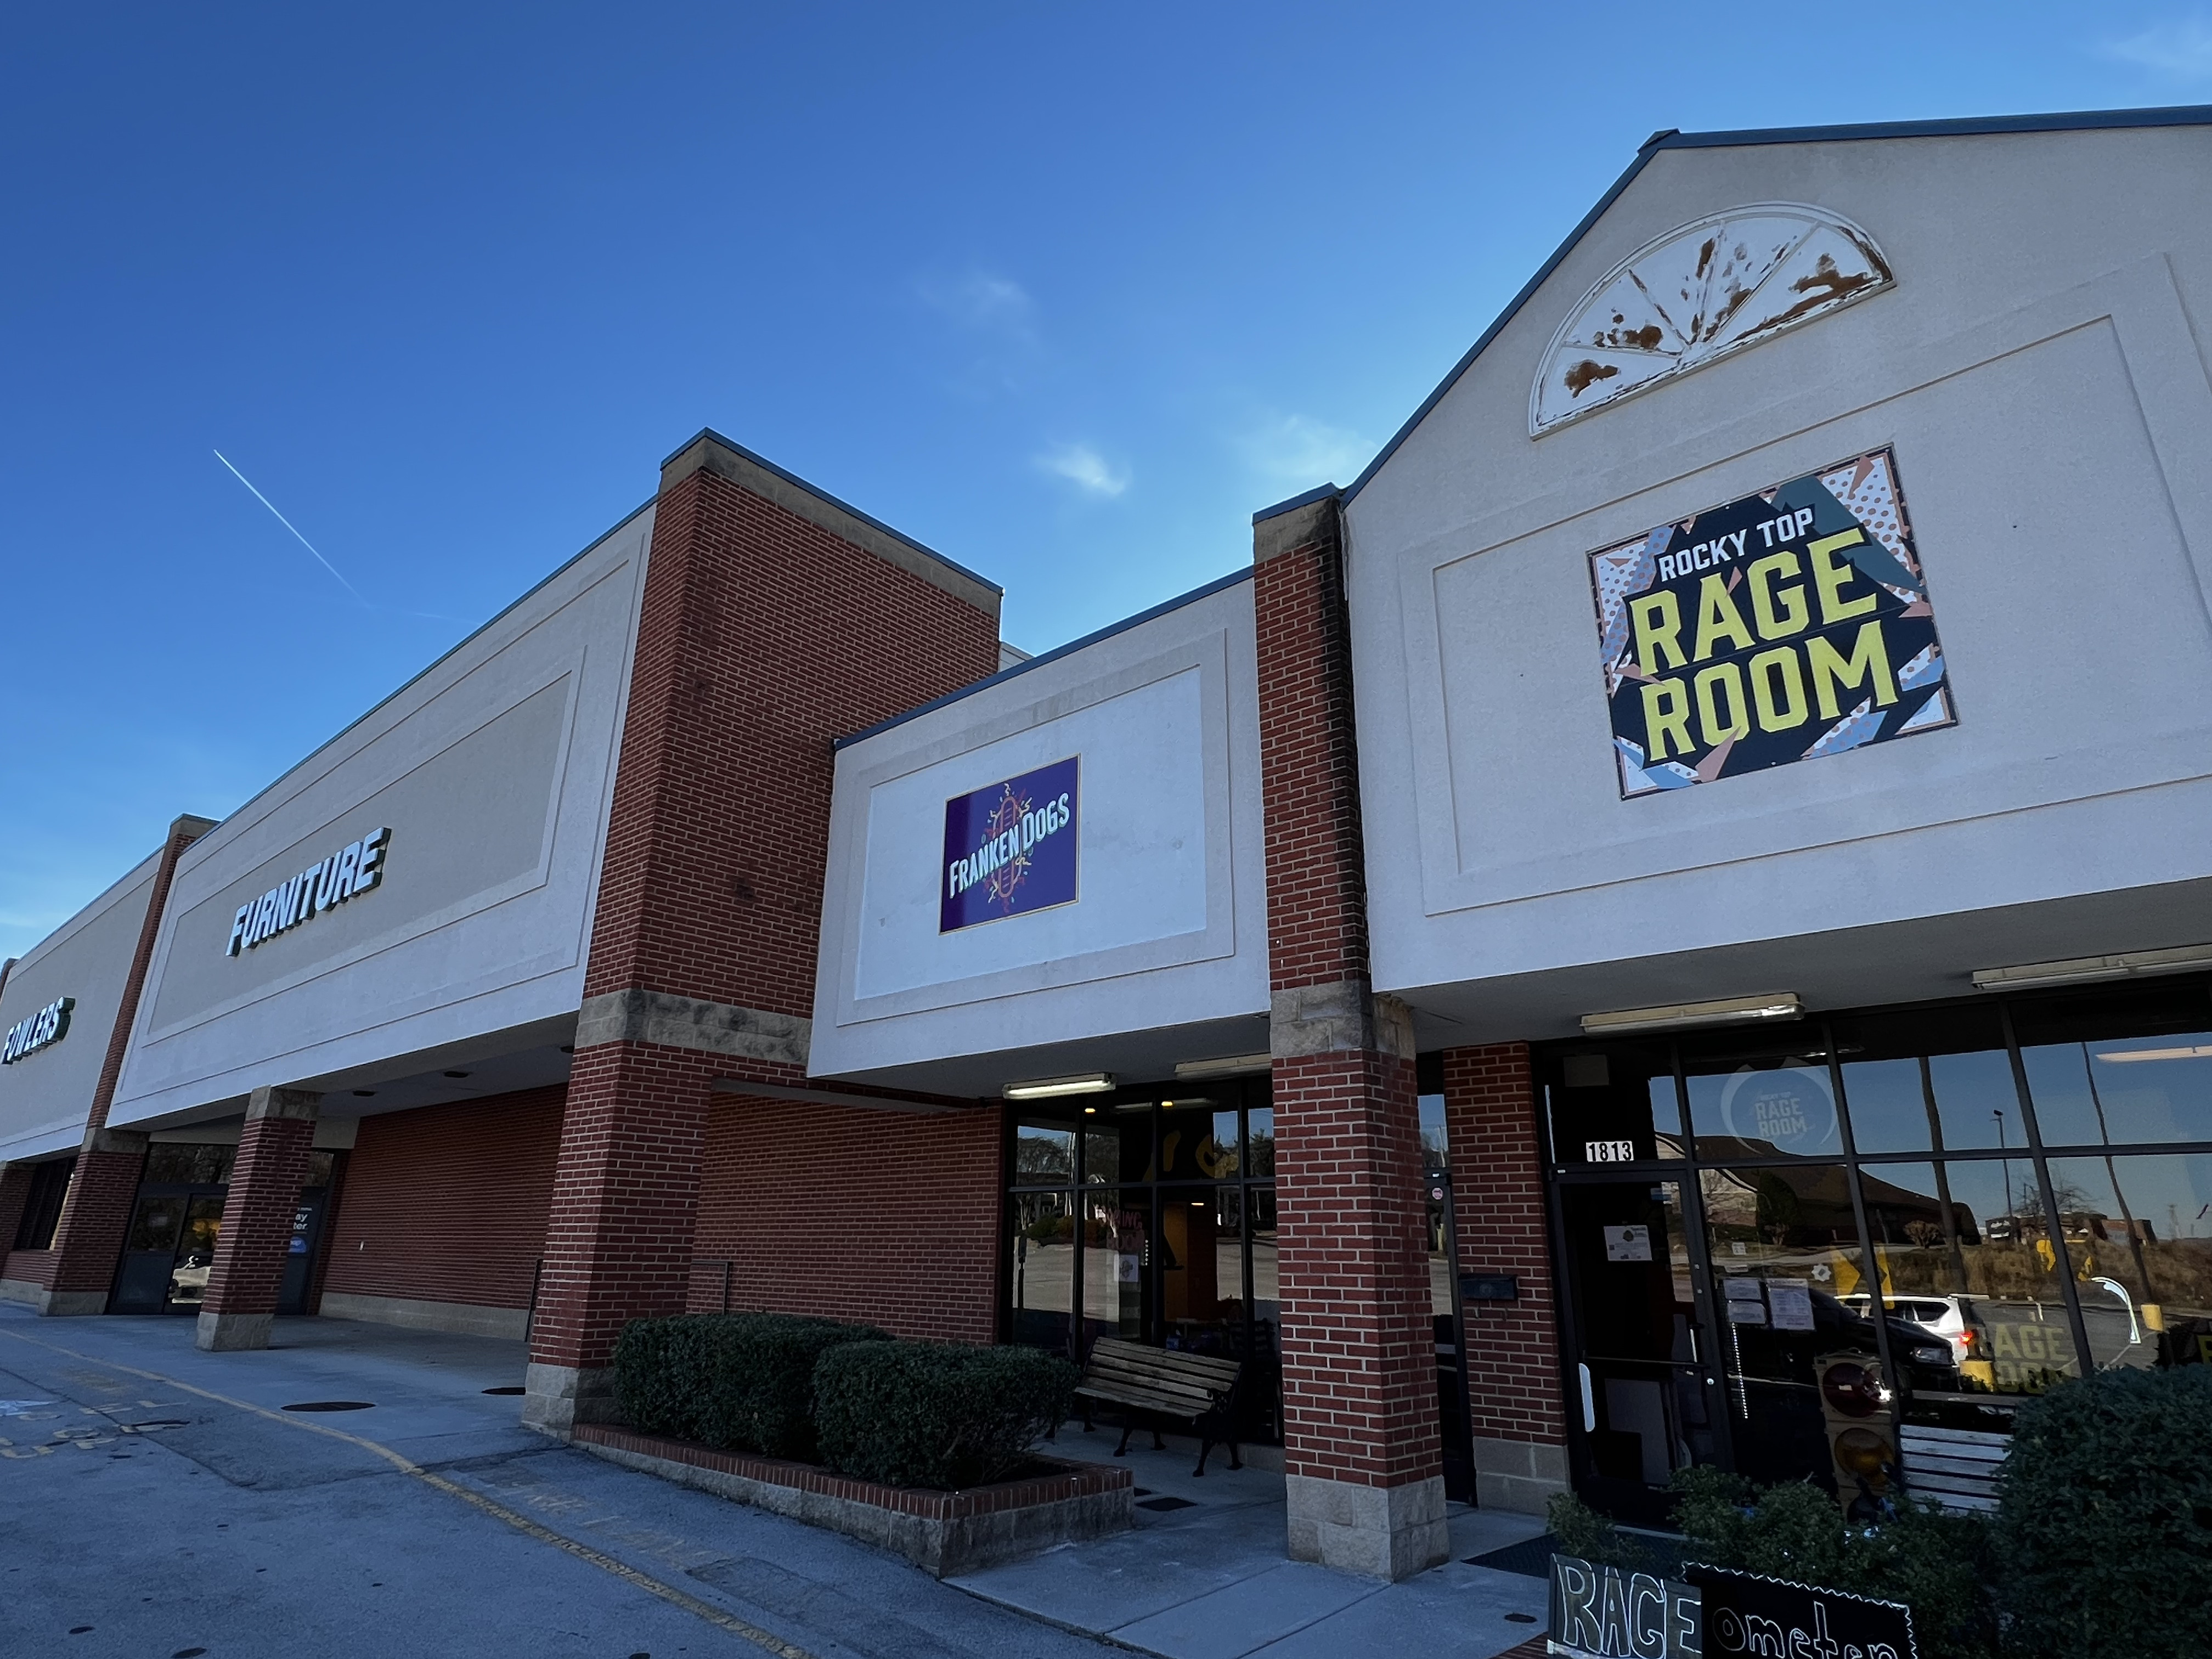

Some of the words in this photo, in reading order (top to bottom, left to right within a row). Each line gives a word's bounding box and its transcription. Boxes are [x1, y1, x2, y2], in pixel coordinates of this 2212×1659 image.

[1657, 528, 1747, 582] ROCKY
[1756, 507, 1813, 548] TOP
[1629, 528, 1879, 676] RAGE
[1639, 619, 1900, 763] ROOM
[949, 824, 1019, 899] FRANKEN
[1022, 792, 1070, 851] DOGS
[225, 826, 391, 957] FURNITURE
[1589, 1142, 1632, 1161] 1813
[1754, 1098, 1803, 1120] RAGE
[1758, 1116, 1807, 1138] ROOM
[1994, 1323, 2070, 1362] AGE
[1551, 1553, 1702, 1658] RAGE
